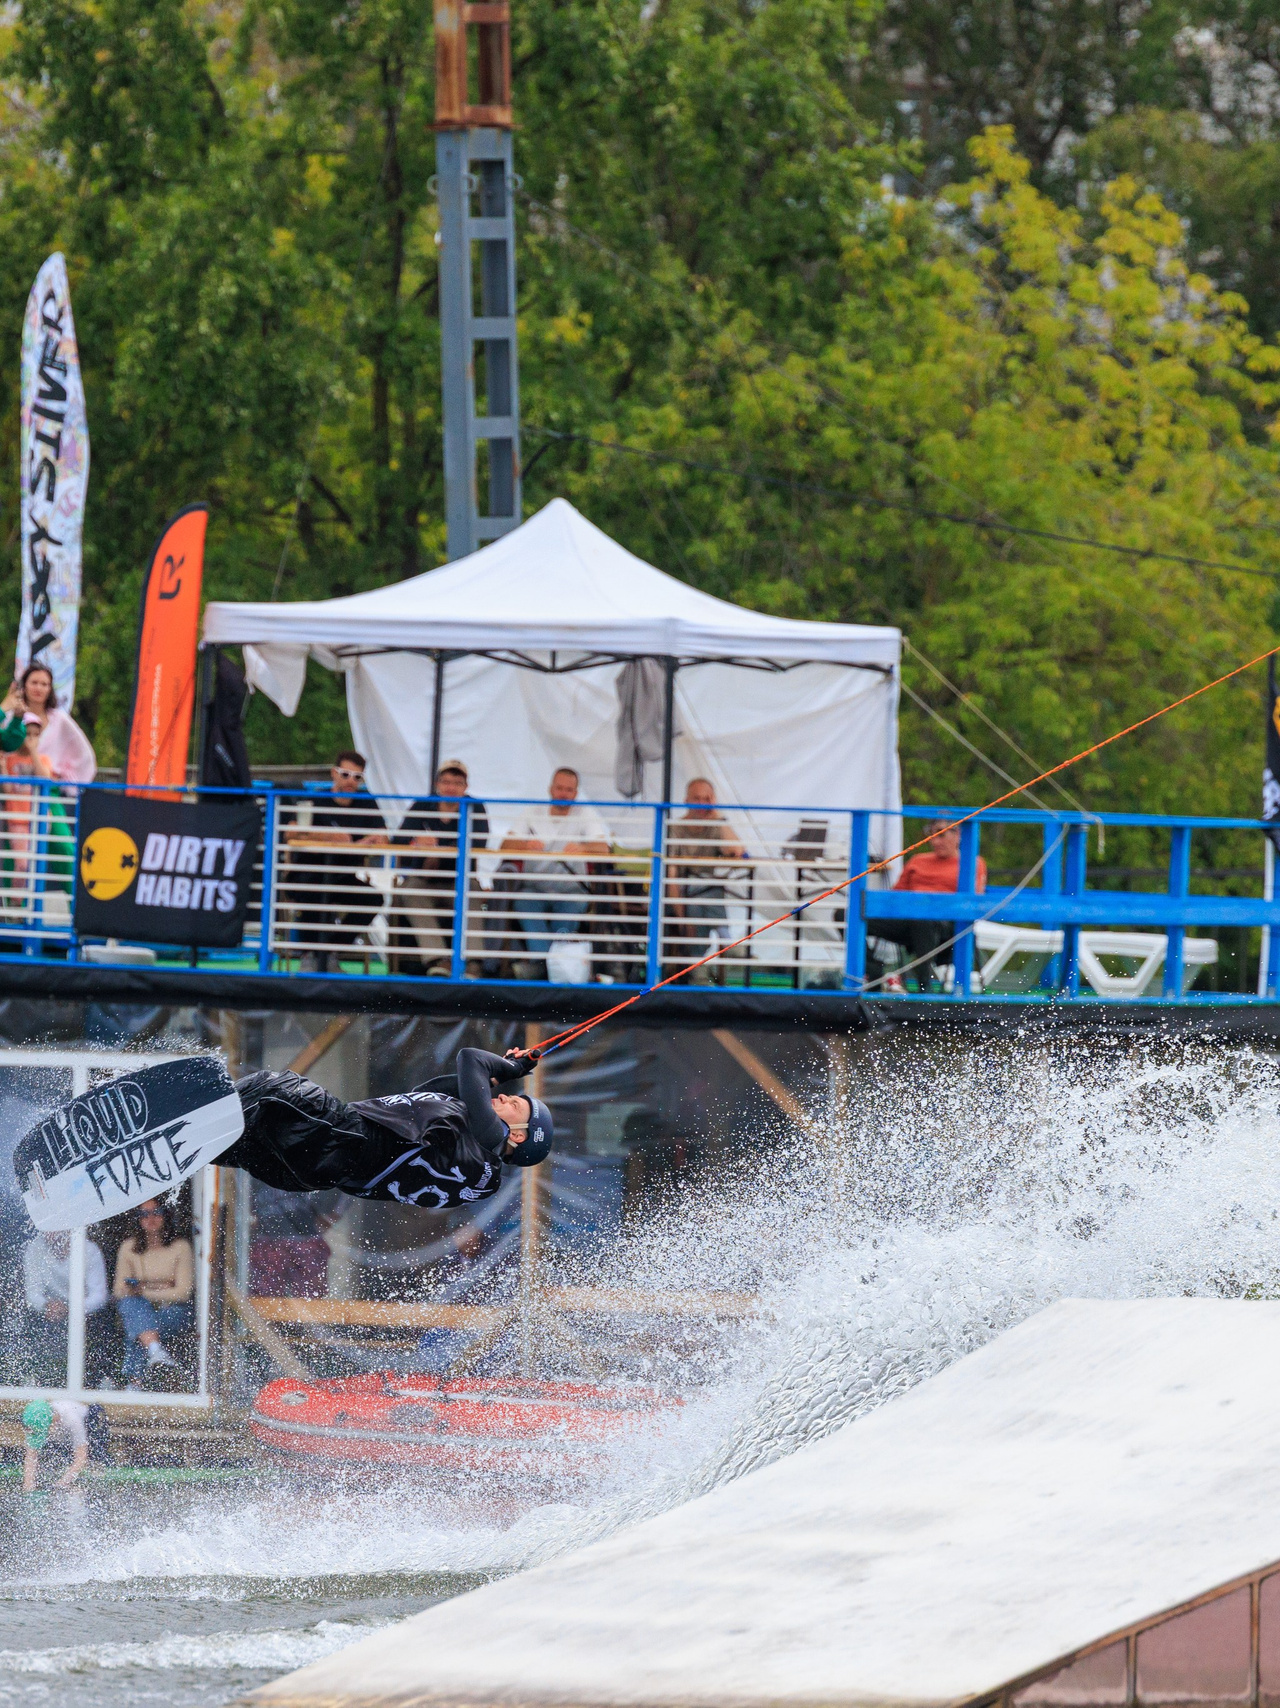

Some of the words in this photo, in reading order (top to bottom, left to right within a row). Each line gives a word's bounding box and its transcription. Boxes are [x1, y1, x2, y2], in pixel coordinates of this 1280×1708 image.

[141, 832, 247, 877] DIRTY
[135, 873, 238, 912] HABITS
[85, 1120, 203, 1206] FORCE
